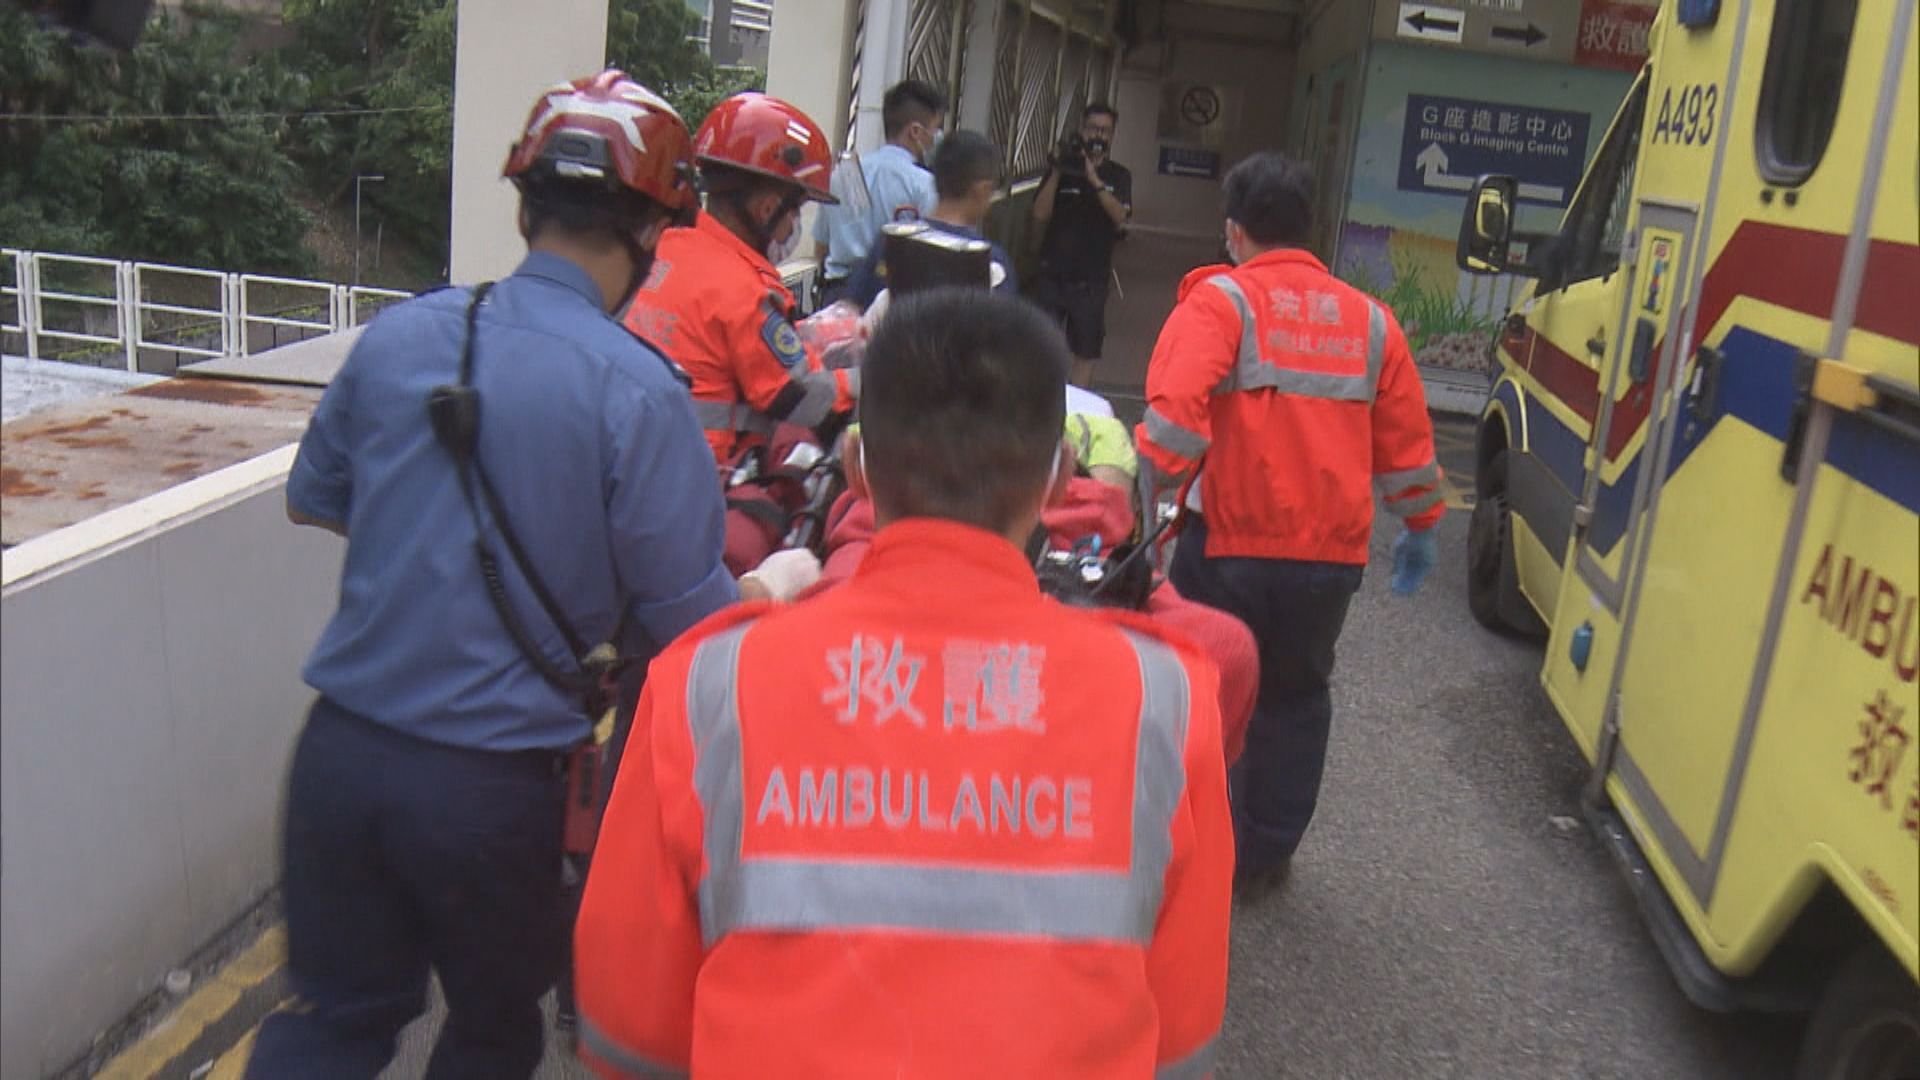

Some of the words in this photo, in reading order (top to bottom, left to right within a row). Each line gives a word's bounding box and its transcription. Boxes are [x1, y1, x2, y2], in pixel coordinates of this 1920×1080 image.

[1420, 127, 1456, 144] Block
[1460, 132, 1470, 145] G
[1473, 134, 1524, 153] Imaging
[1527, 140, 1569, 157] Centre
[1652, 83, 1718, 146] A493
[823, 633, 1046, 734] 救護
[757, 766, 1093, 840] AMBULANCE
